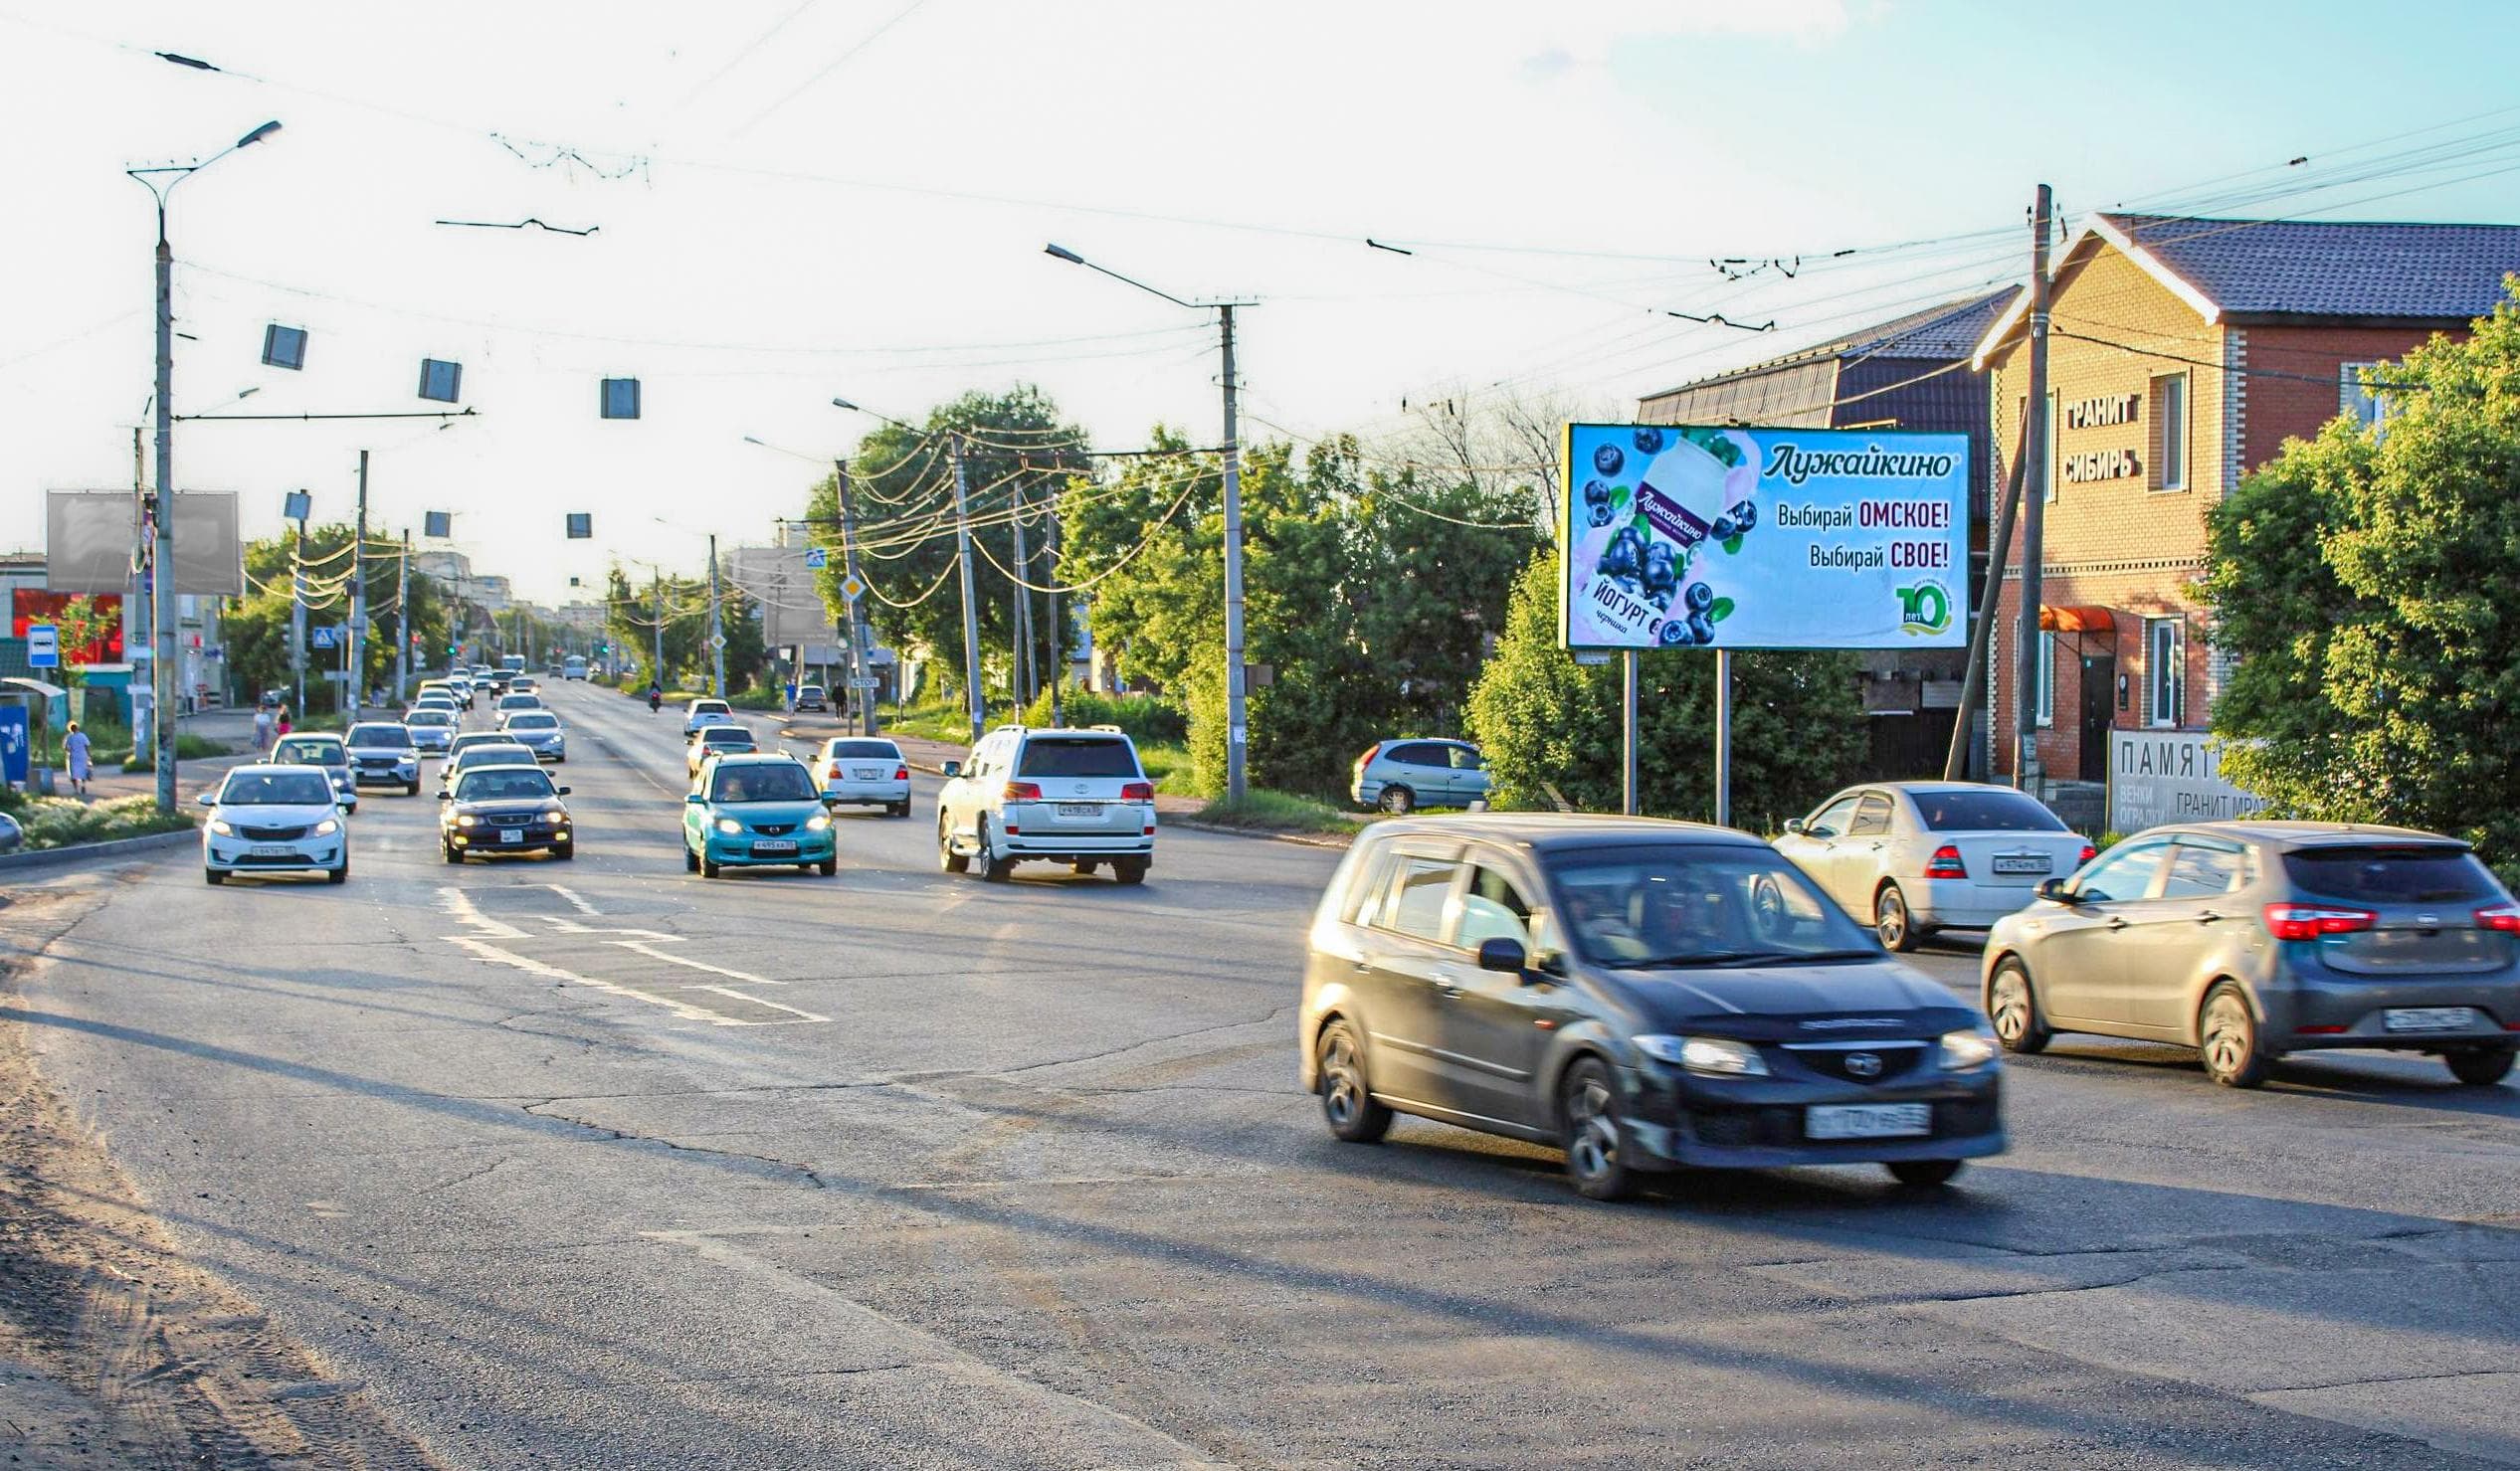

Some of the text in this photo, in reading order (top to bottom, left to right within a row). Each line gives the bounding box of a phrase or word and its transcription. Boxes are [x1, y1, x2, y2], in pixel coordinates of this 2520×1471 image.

[2064, 394, 2132, 429] ГРАНИТ
[1765, 445, 1951, 483] Лужайкино
[2064, 448, 2132, 482] СИБИРЬ
[1638, 490, 1702, 540] Лужайкино
[1778, 501, 1949, 531] Выбирай ОМСКОЕ!
[1810, 542, 1949, 572] Выбирай СВОЕ!
[1593, 579, 1649, 628] ЙОГУРТ
[1896, 586, 1946, 628] 10
[1905, 612, 1922, 622] лет
[1596, 610, 1629, 635] черника
[2121, 741, 2224, 779] ПАМЯТ
[2120, 786, 2153, 805] ВЕНКИ
[2177, 792, 2268, 819] ГРАНИТ МРА
[2120, 809, 2165, 827] ОГРАДКИ
